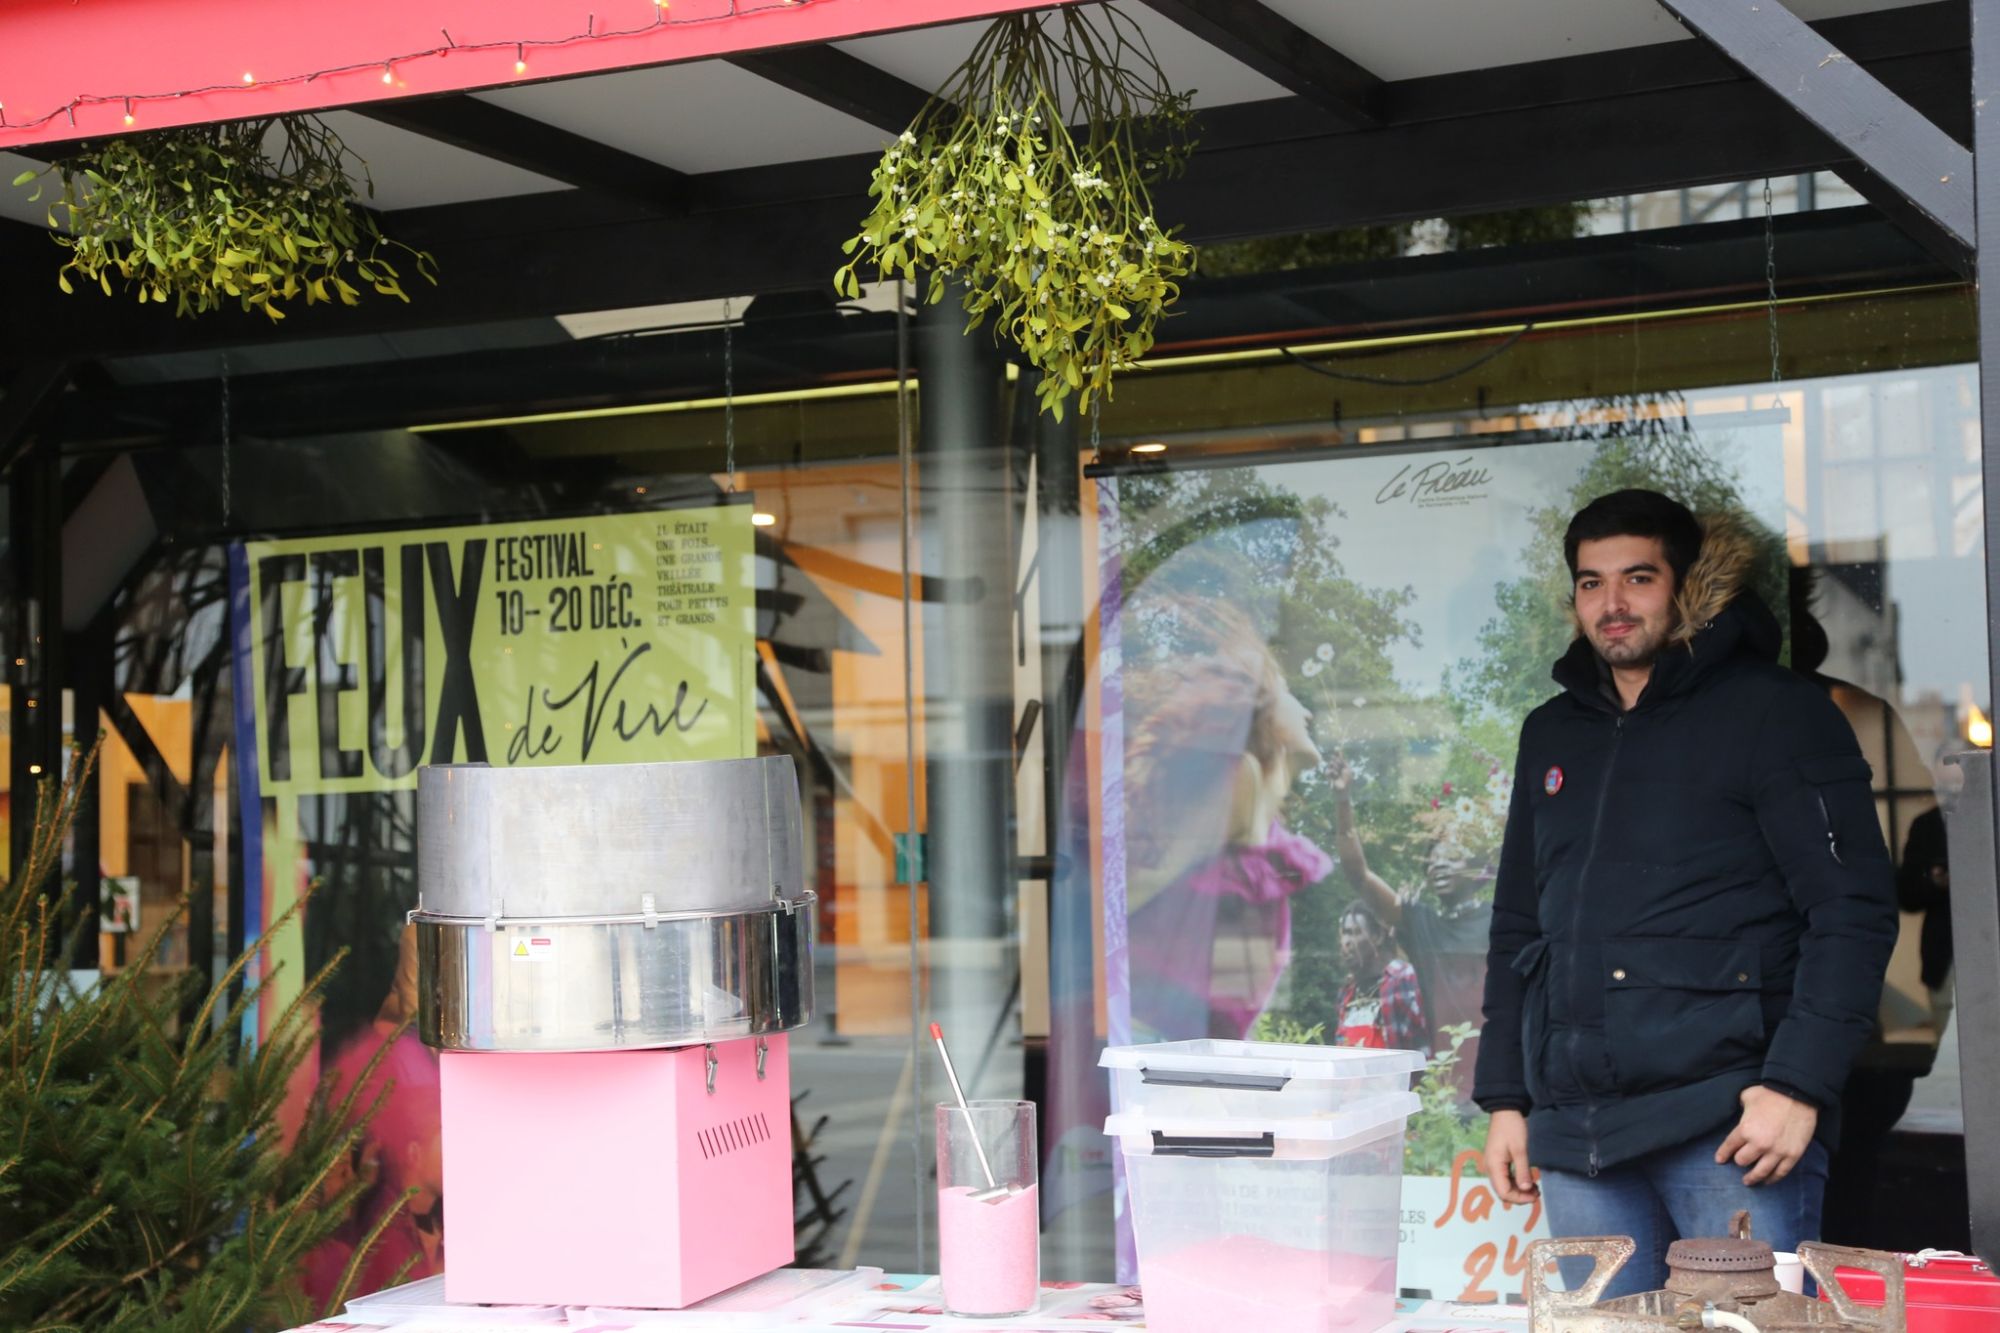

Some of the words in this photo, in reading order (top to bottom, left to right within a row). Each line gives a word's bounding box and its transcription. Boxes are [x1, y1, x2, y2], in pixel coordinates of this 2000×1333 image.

[1375, 464, 1411, 504] Le
[1410, 456, 1495, 503] Préau
[674, 521, 708, 535] ÉTAIT
[656, 540, 675, 551] UNE
[495, 532, 594, 583] FESTIVAL
[656, 555, 676, 566] UNE
[681, 552, 722, 564] GRANDE
[656, 567, 702, 581] VEILLÉE
[657, 582, 715, 597] THÉÂTRALE
[590, 574, 642, 630] DÉC.
[657, 600, 682, 612] POUR
[687, 596, 729, 609] PETITS
[657, 615, 671, 627] ET
[675, 613, 715, 625] GRANDS
[258, 538, 489, 782] FEUX
[507, 685, 563, 765] de
[542, 637, 709, 763] Vire
